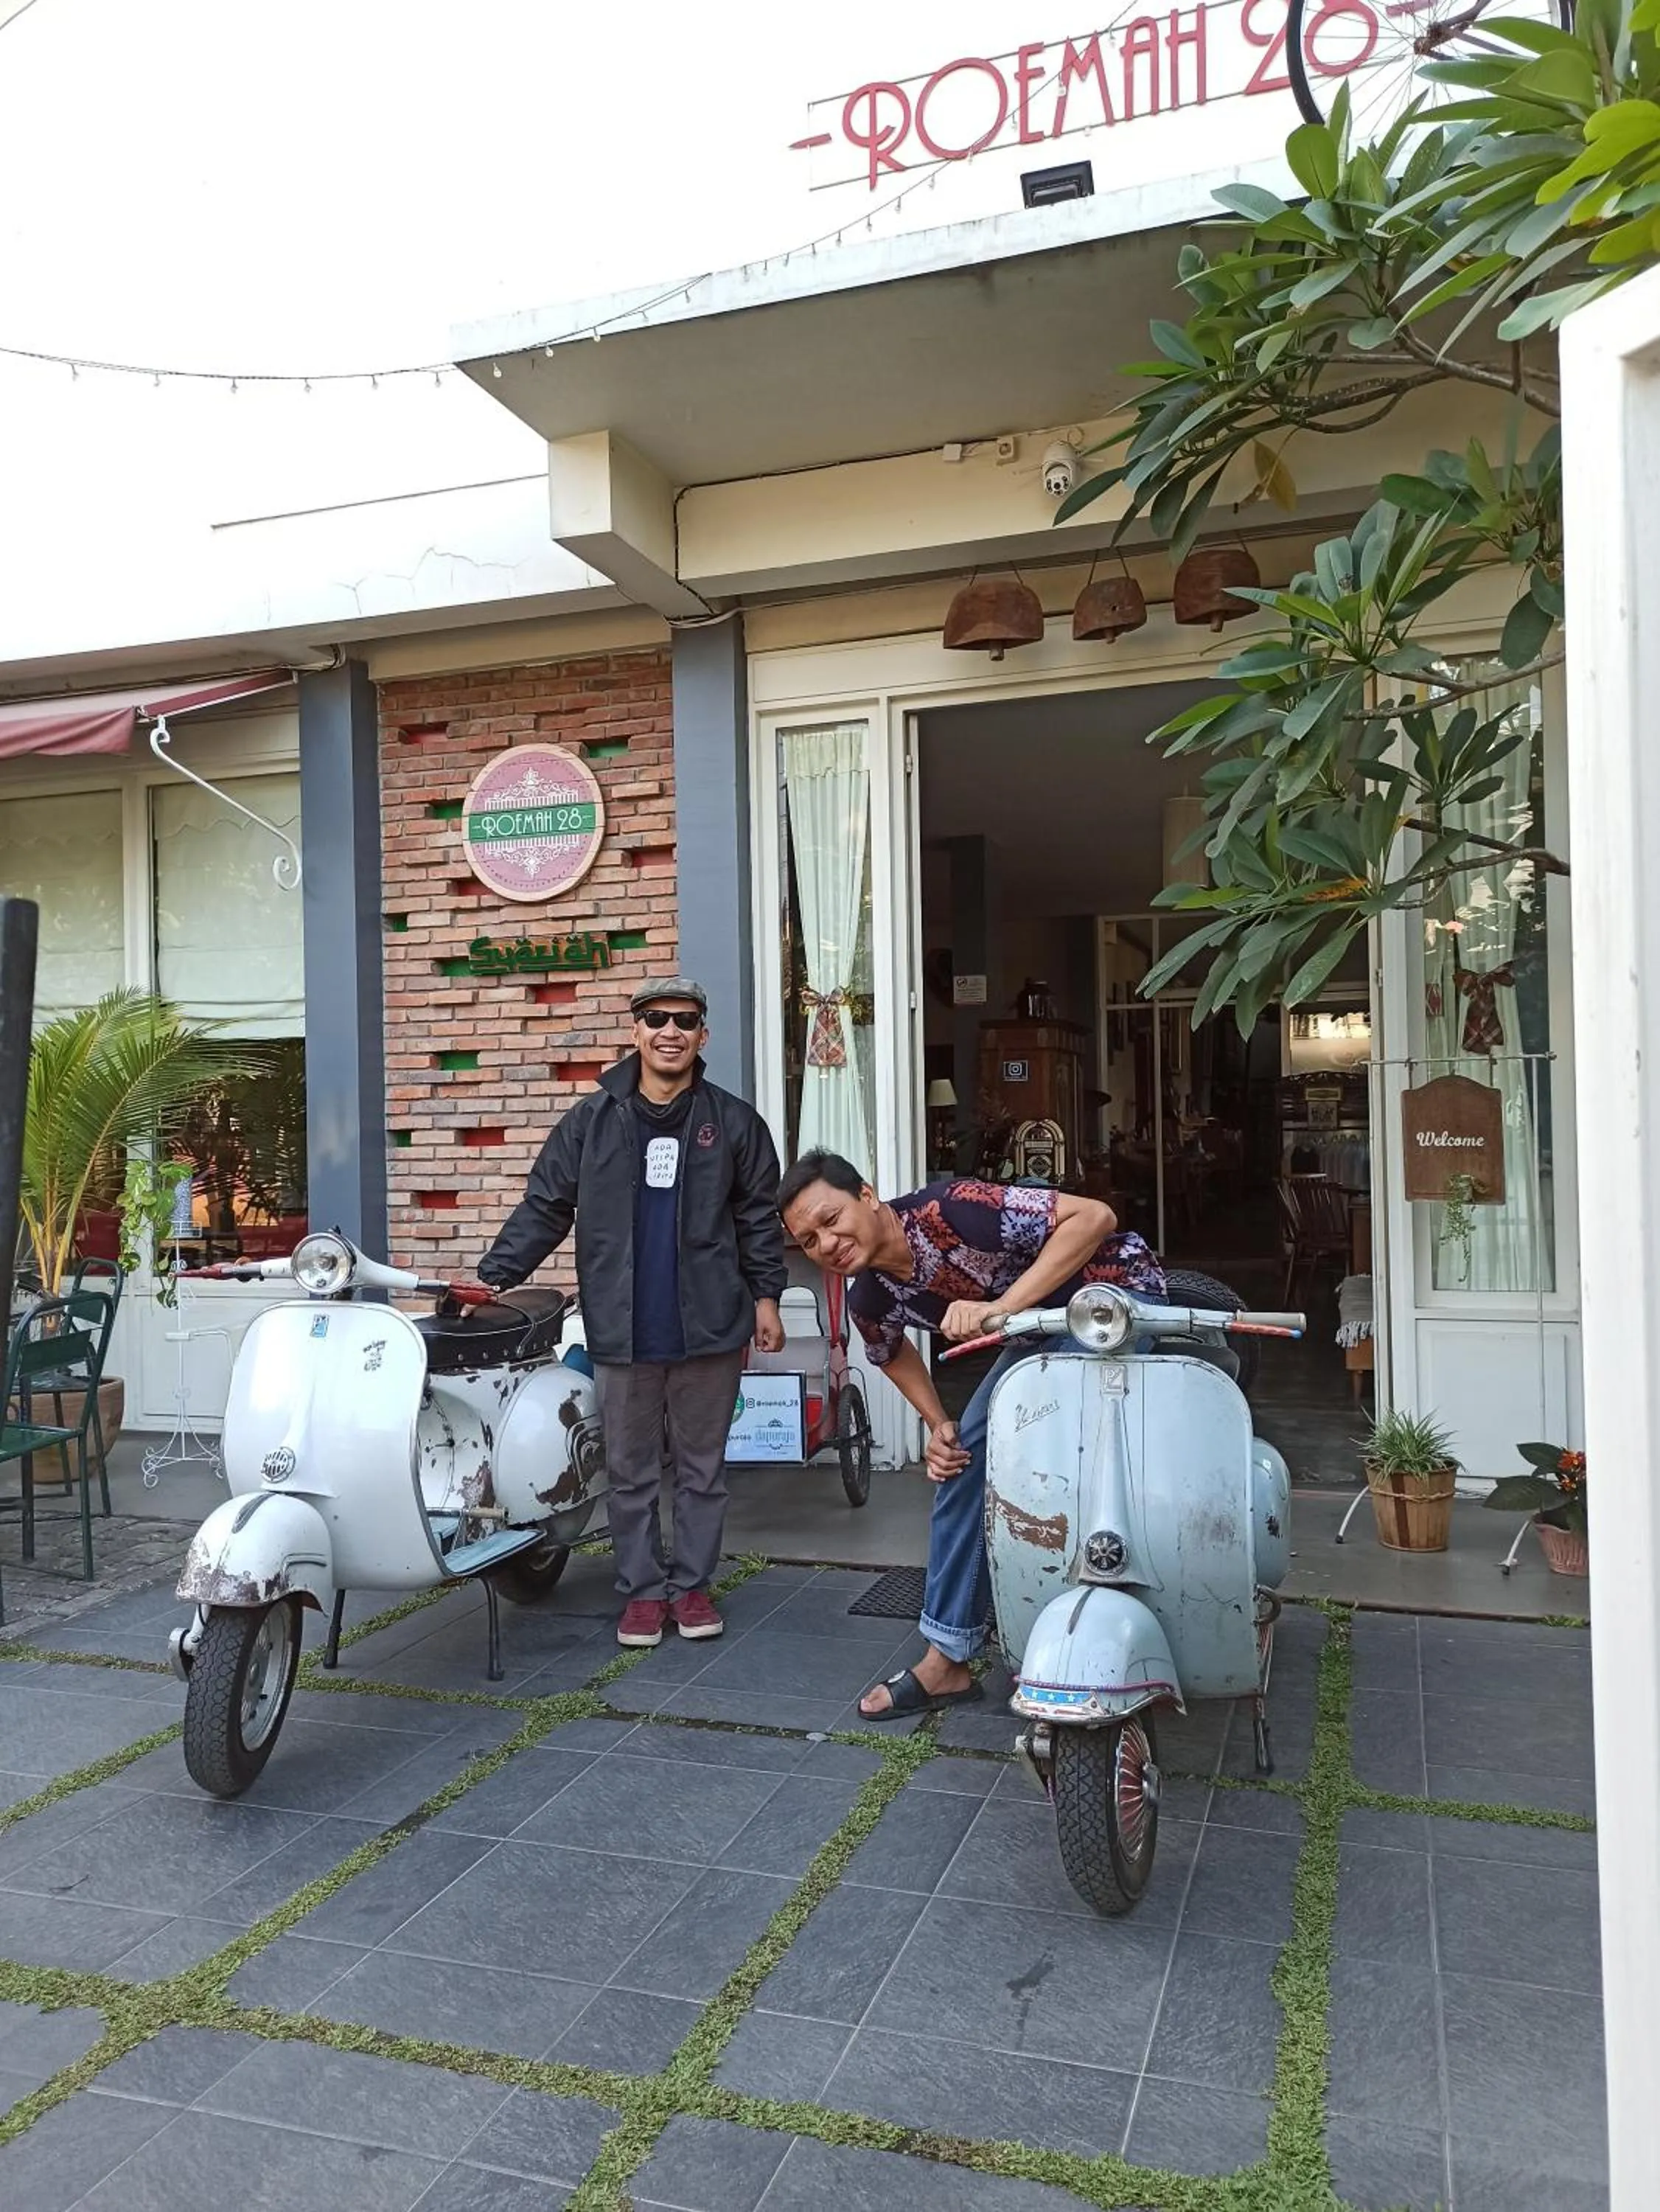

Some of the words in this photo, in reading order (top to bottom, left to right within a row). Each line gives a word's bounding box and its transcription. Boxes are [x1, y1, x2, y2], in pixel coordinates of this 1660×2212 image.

[843, 3, 1207, 191] ROEMAH
[481, 810, 553, 838] ROEMAH
[557, 808, 582, 831] 28
[1415, 1130, 1485, 1147] Welcome
